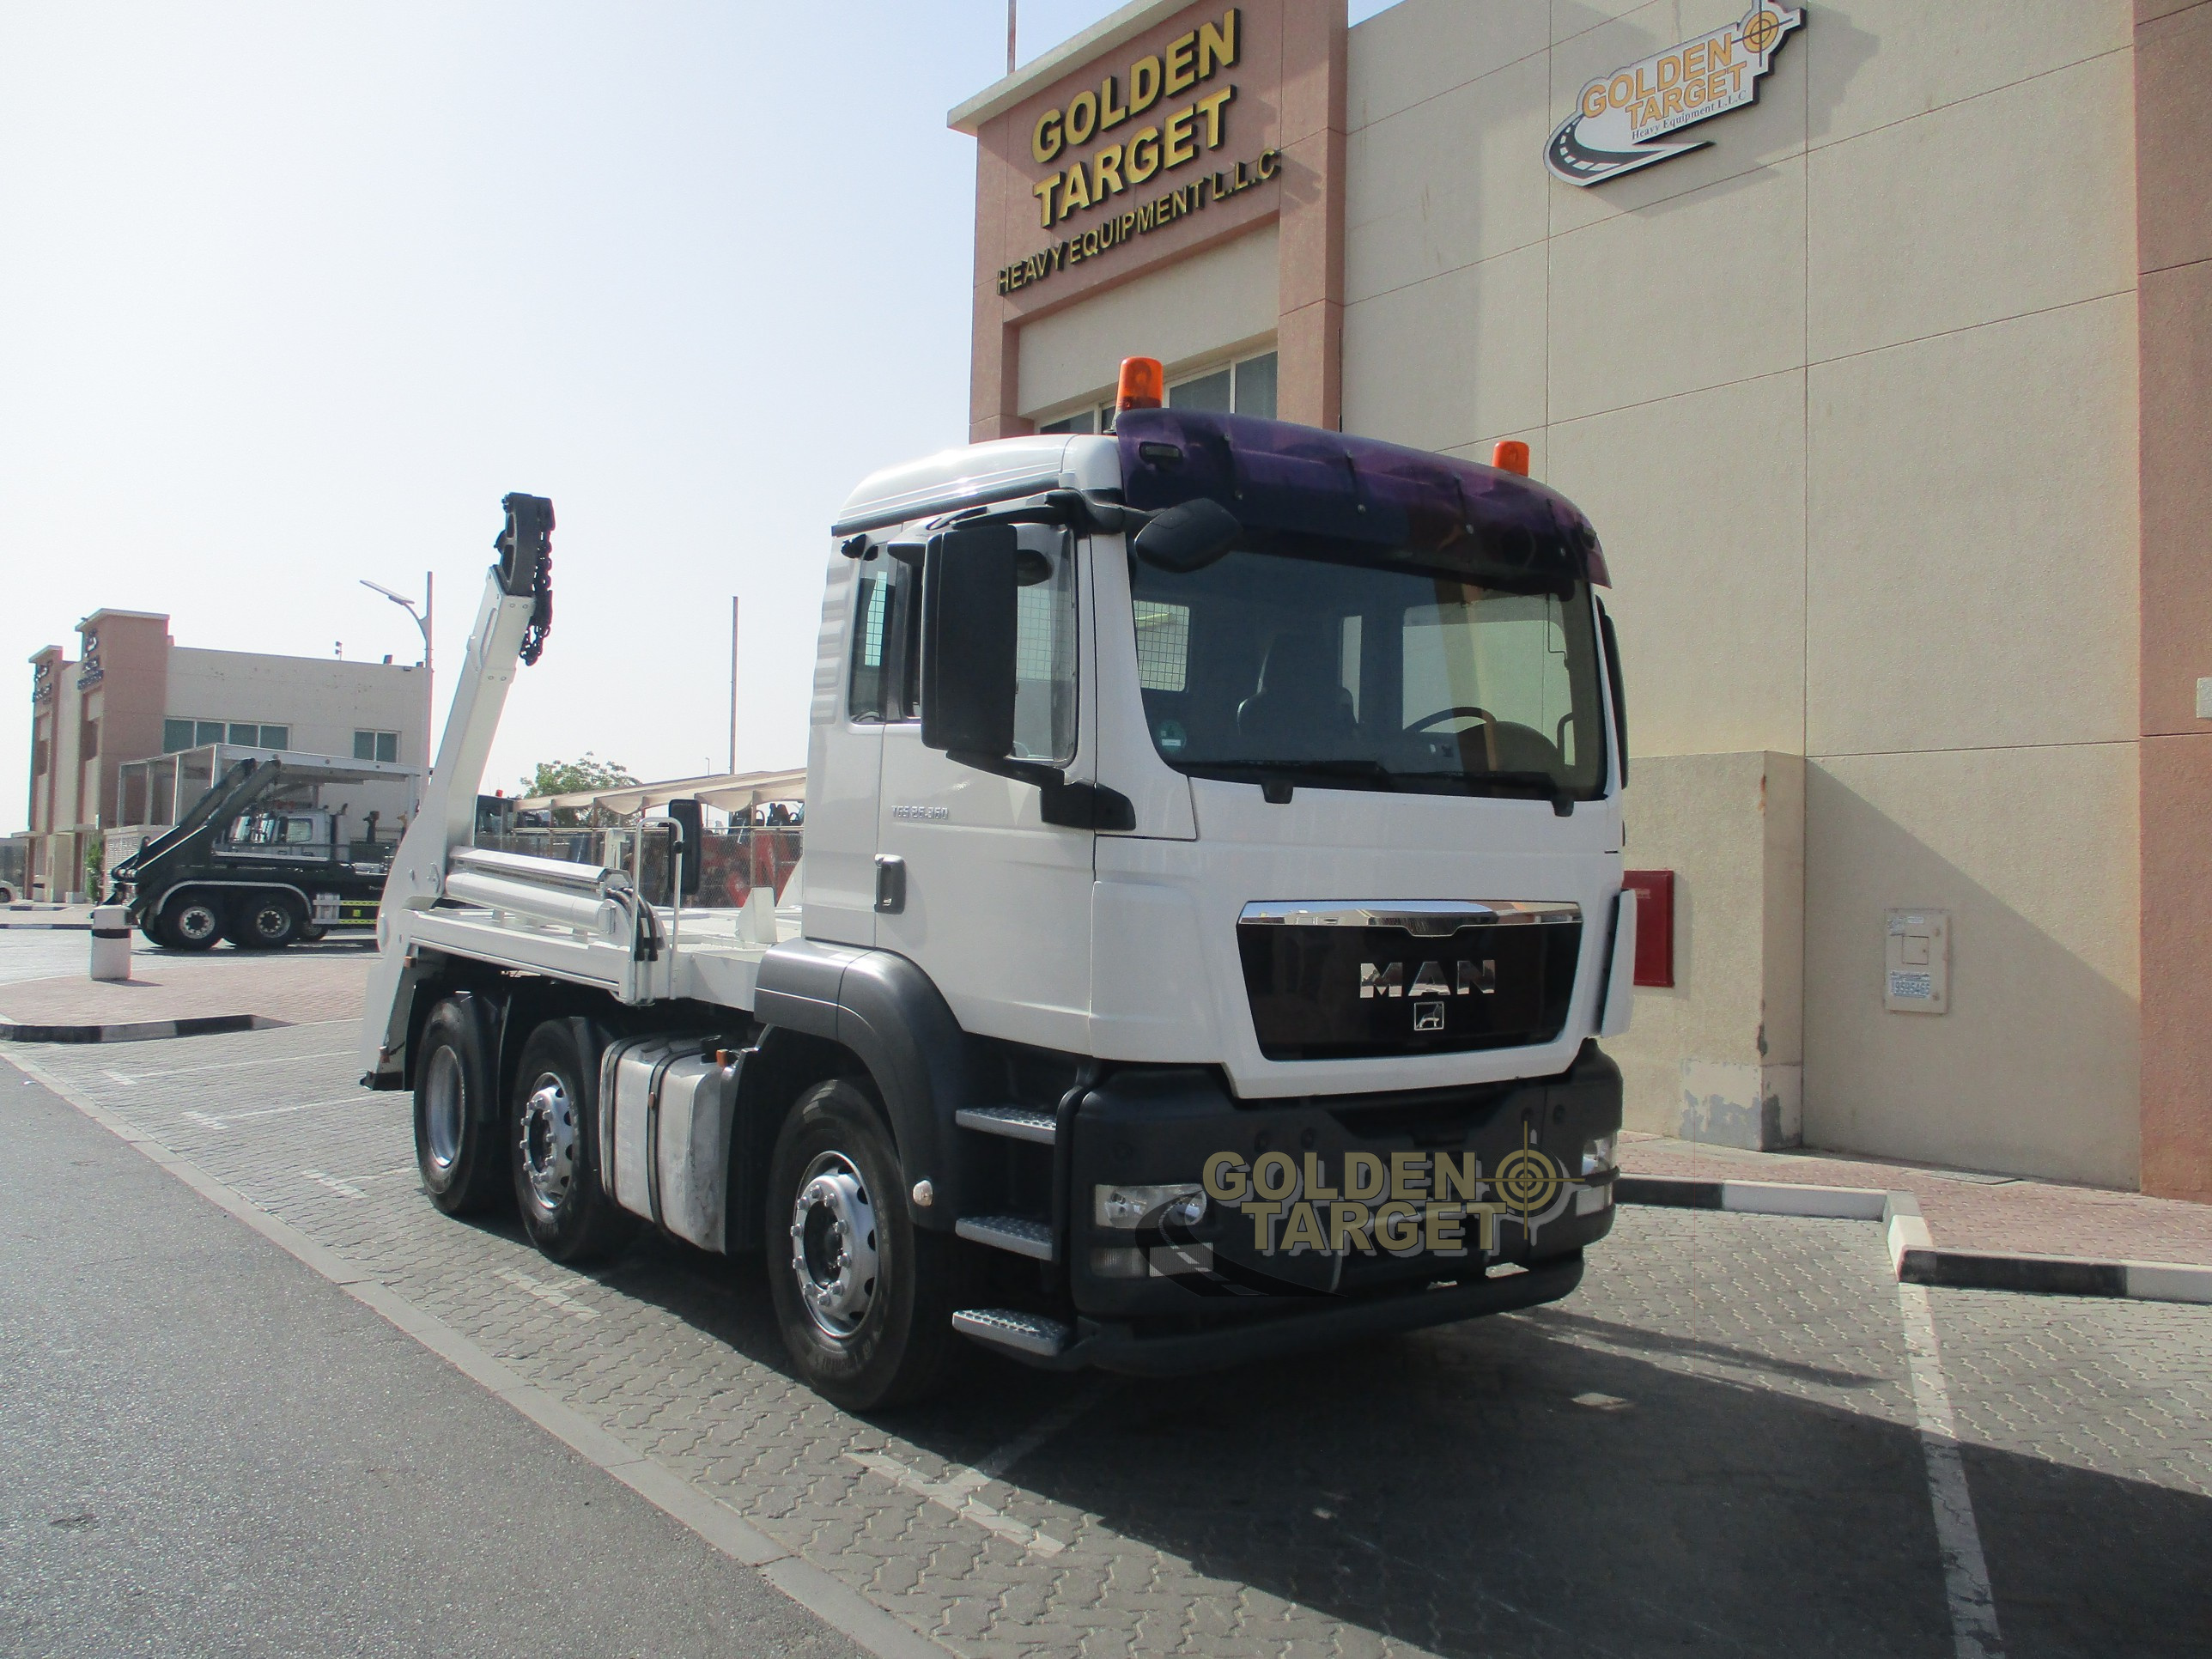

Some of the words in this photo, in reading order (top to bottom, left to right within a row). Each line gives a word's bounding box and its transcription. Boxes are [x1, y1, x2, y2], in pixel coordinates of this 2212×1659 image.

[1031, 8, 1241, 164] GOLDEN
[1583, 33, 1732, 118] GOLDEN
[1626, 61, 1747, 130] TARGET
[1032, 85, 1237, 229] TARGET
[1632, 124, 1661, 140] Heavy
[1663, 102, 1716, 130] Equipment
[997, 240, 1068, 295] HEAVY
[1069, 177, 1212, 264] EQUIPMENT
[1359, 959, 1496, 999] MAN
